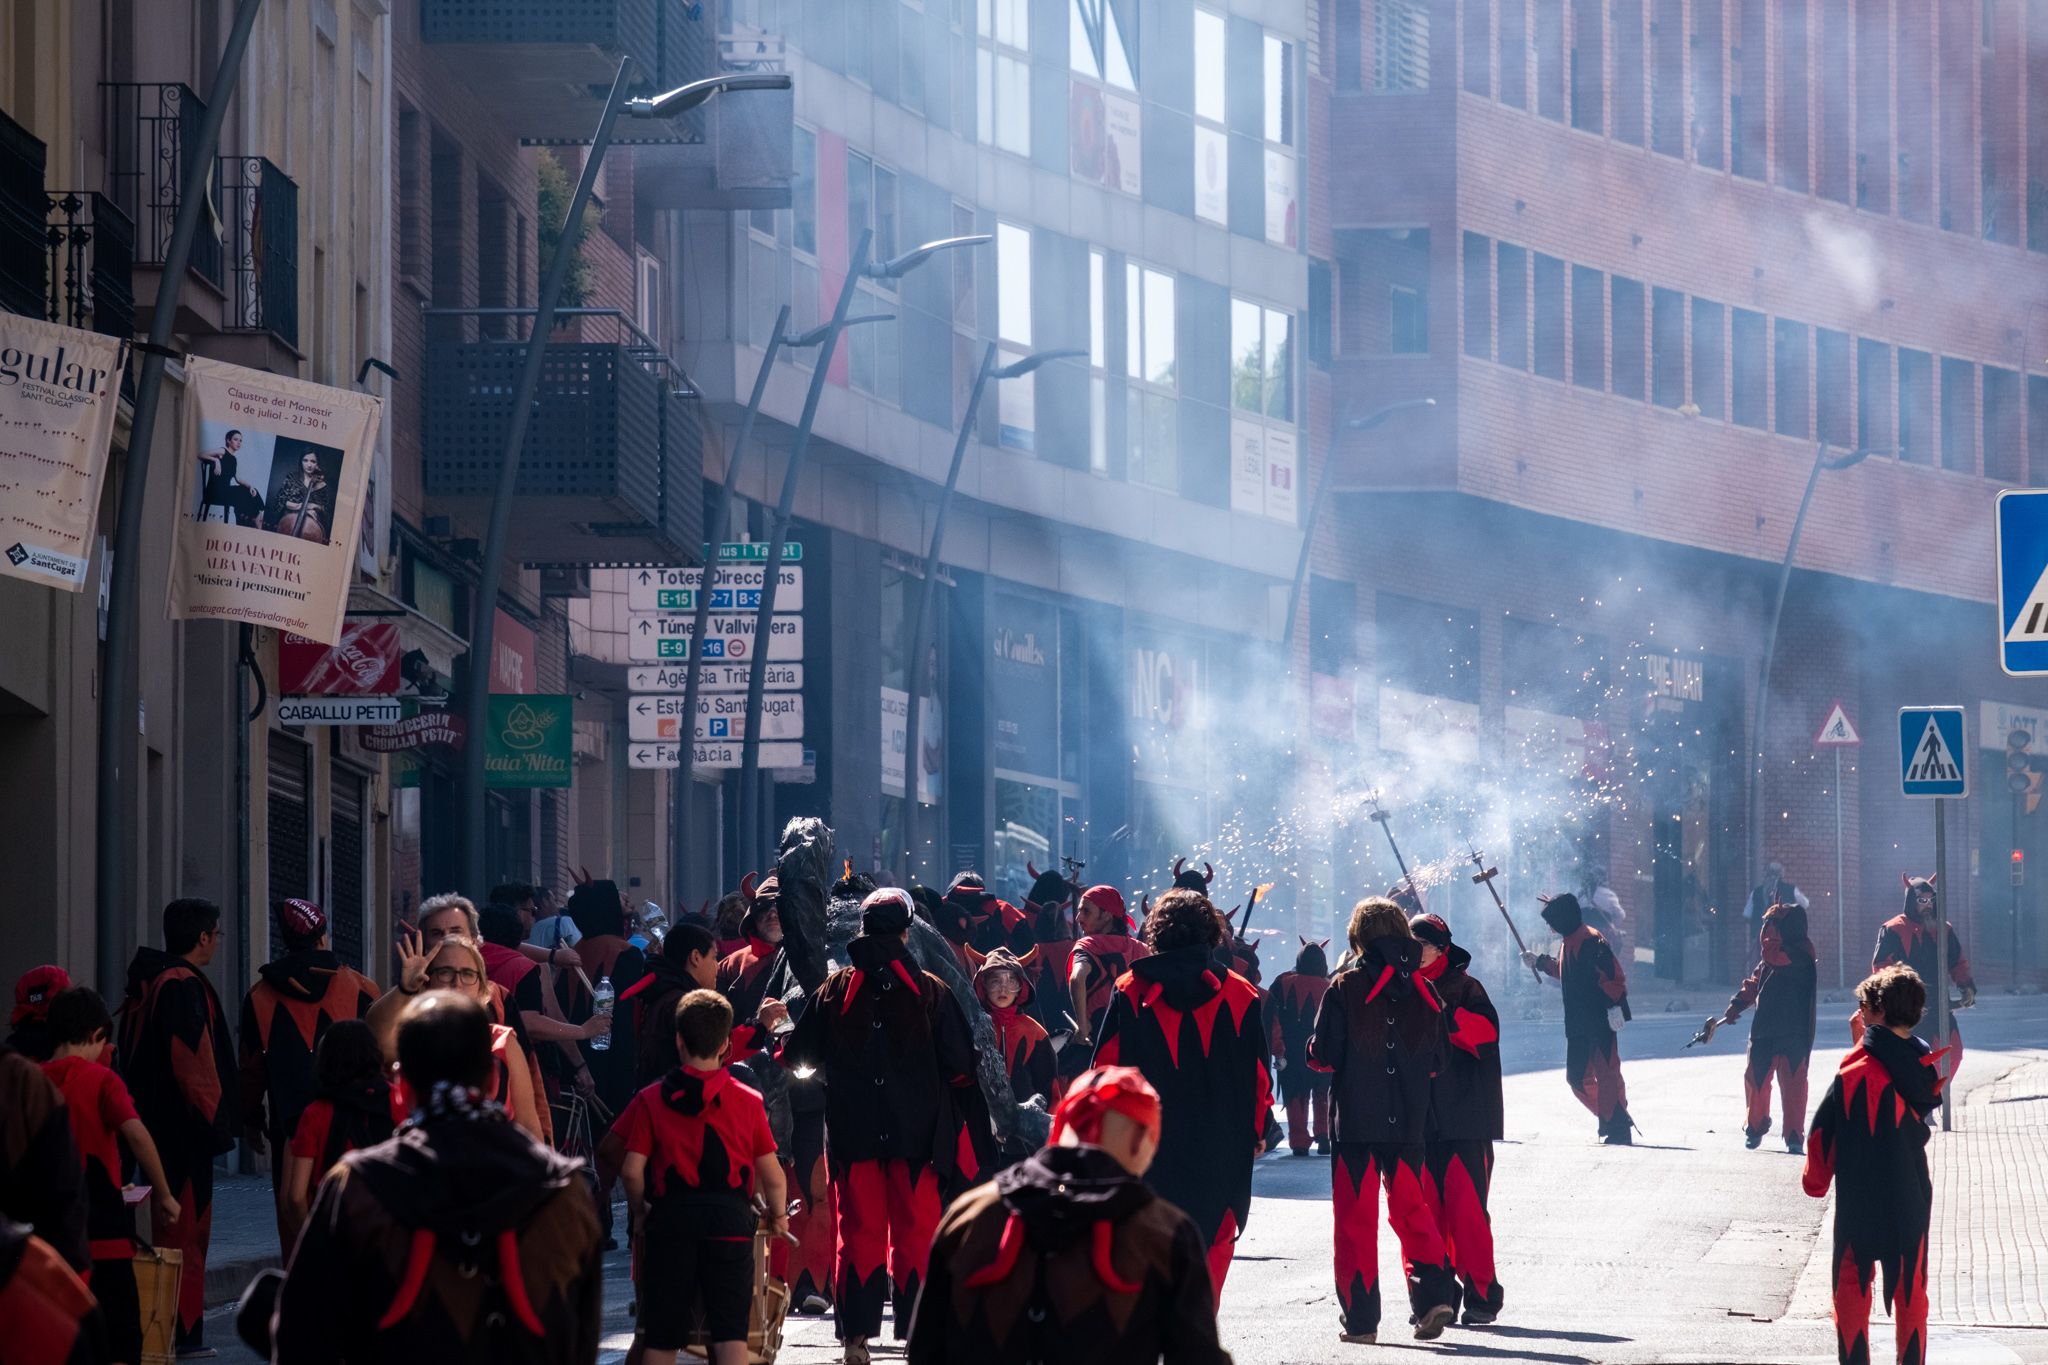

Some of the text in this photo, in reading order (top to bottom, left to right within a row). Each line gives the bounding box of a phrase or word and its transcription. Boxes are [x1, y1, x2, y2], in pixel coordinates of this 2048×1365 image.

[23, 382, 56, 398] FESTIVAL
[21, 390, 73, 409] SANT CUGAT
[228, 387, 333, 418] Claustre del Monestir
[229, 400, 240, 411] 10
[243, 405, 255, 415] de
[257, 406, 281, 421] juliol
[292, 415, 319, 428] 21.30
[321, 421, 328, 431] h
[206, 539, 301, 566] DUO LAIA PUIG
[751, 544, 795, 557] Taet
[31, 558, 76, 576] SantCugat
[206, 557, 302, 585] ALBA VENTURA
[235, 577, 240, 588] i
[657, 569, 796, 585] Totes Direccins
[660, 592, 689, 605] E-15
[738, 592, 761, 605] B-3
[189, 604, 309, 630] santcugat.cat/festivalangular
[714, 618, 796, 635] Vallviera
[660, 642, 683, 654] E-9
[700, 642, 722, 654] -16
[657, 667, 795, 689] Agècia Tribtària
[278, 705, 401, 721] CABALLU PETIT
[656, 697, 796, 716] Estaió Sant ugat
[421, 728, 457, 744] PETIT
[656, 745, 732, 763] Faàcia
